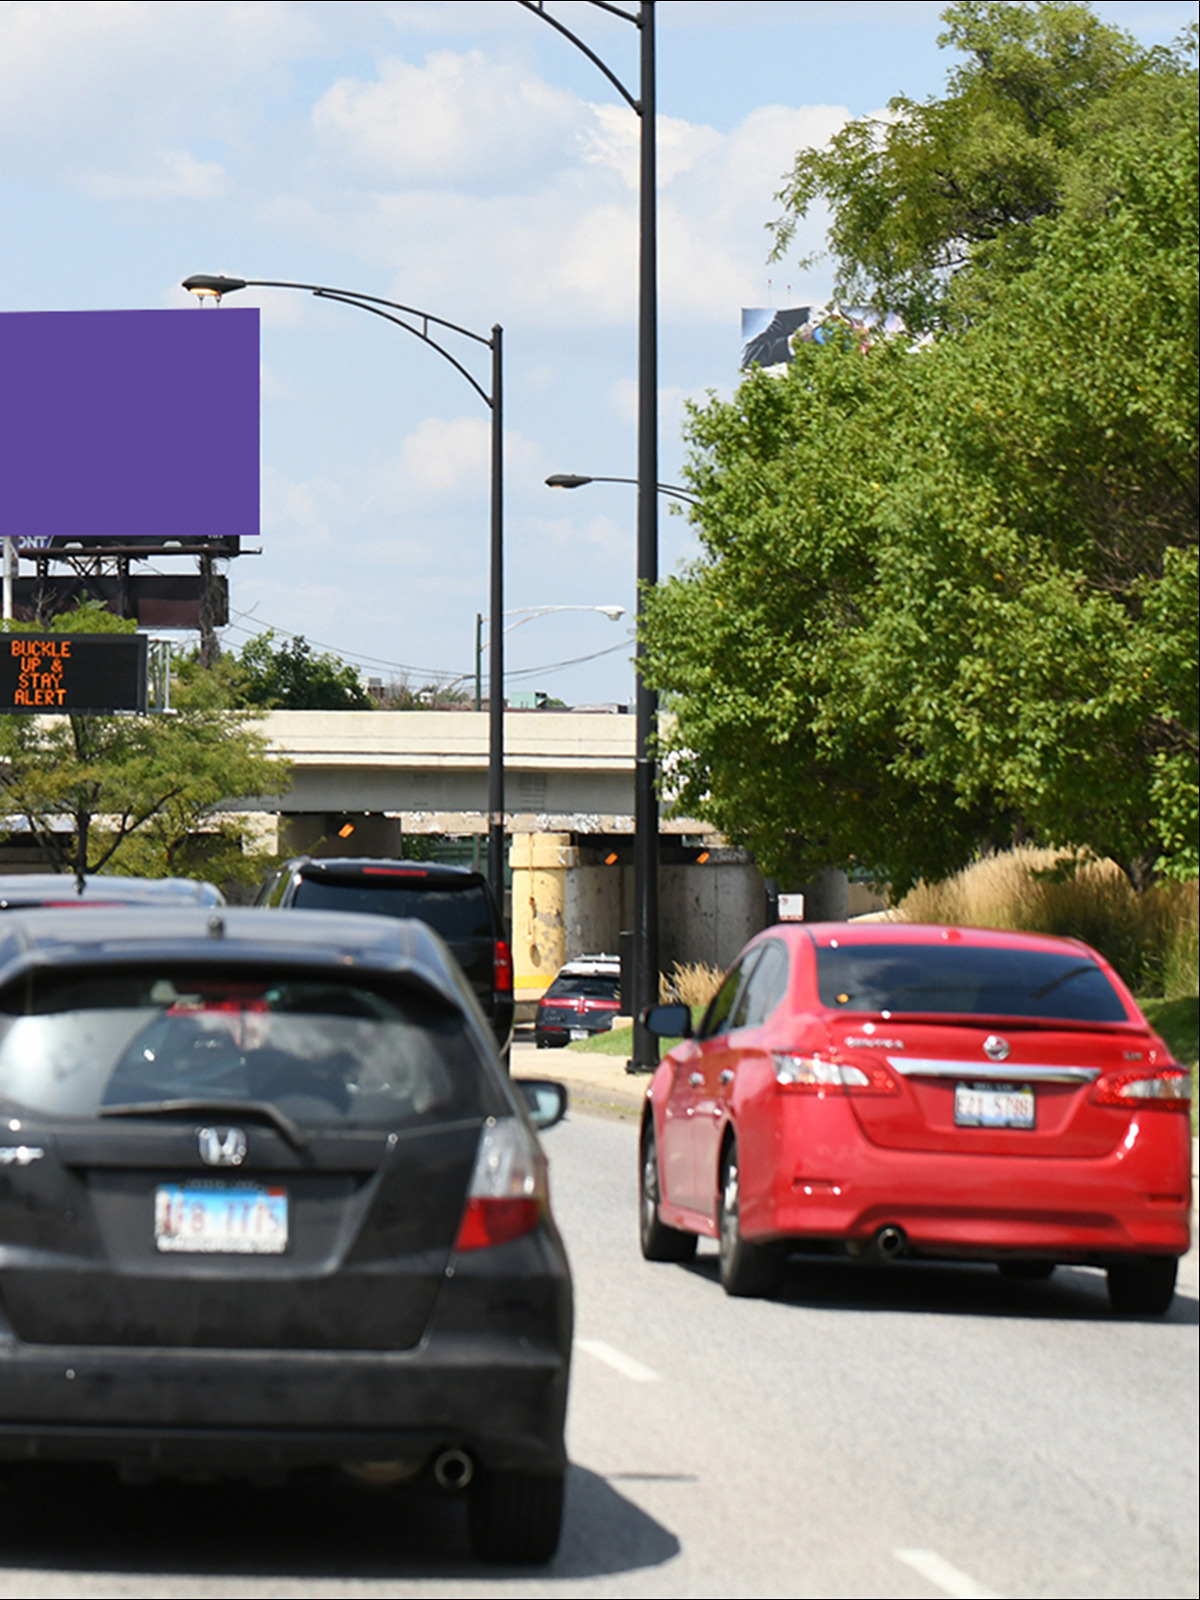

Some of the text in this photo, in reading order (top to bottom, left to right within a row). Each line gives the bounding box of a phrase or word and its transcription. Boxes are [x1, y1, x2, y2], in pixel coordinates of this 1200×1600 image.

[11, 640, 72, 657] BUCKLE
[21, 657, 63, 672] UP &
[18, 672, 64, 689] STAY
[14, 688, 67, 705] ALERT
